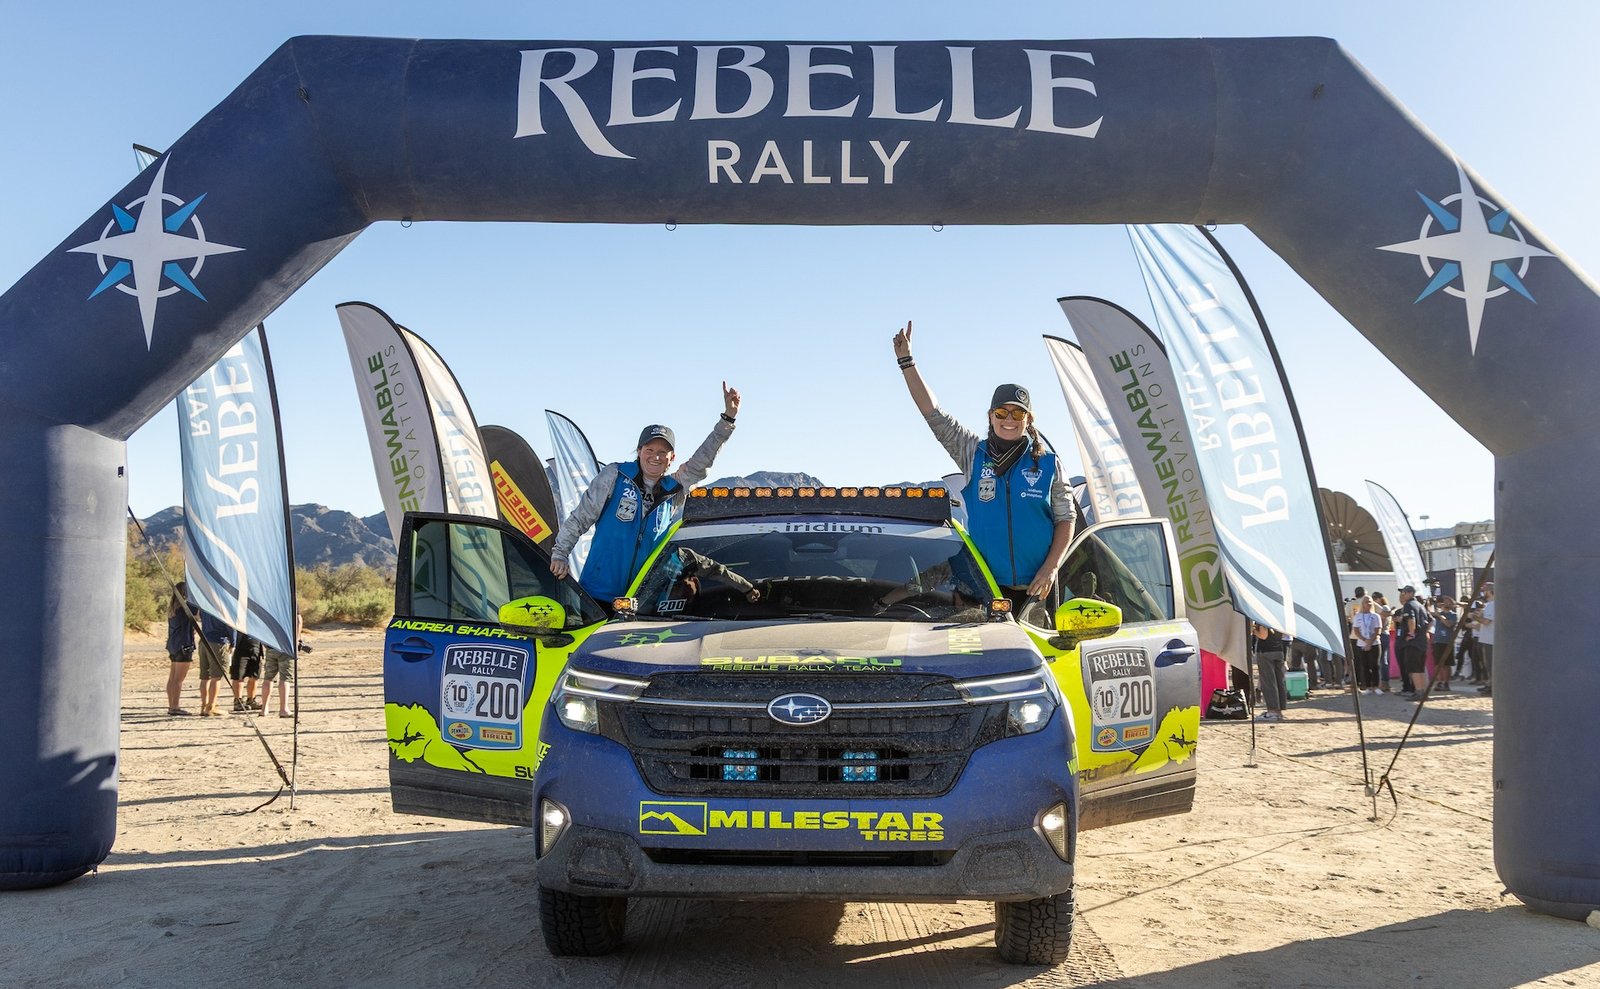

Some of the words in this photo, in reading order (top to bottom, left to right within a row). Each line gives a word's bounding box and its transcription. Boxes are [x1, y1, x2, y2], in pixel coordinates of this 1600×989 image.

[513, 44, 1104, 159] REBELLE
[708, 140, 911, 184] RALLY
[368, 351, 420, 512] ENEWABLE
[1130, 343, 1211, 537] INNOVATIONS
[1109, 350, 1194, 544] RENEWABLE
[492, 471, 543, 538] PIRELLI
[785, 522, 882, 533] iridium
[659, 600, 685, 611] 200
[390, 620, 454, 634] ANDREA
[452, 650, 518, 670] REBELLE
[701, 655, 903, 667] SUBARU
[1093, 652, 1146, 674] REBELLE
[471, 666, 496, 675] RALLY
[1112, 668, 1131, 677] RALLY
[451, 685, 468, 702] 10
[475, 681, 519, 720] 200
[1100, 690, 1114, 707] 10
[1119, 679, 1153, 719] 200
[482, 729, 513, 741] PIRELLI
[1125, 727, 1149, 739] PIRELLI
[709, 810, 945, 830] MILESTAR
[860, 830, 945, 841] TIRES
